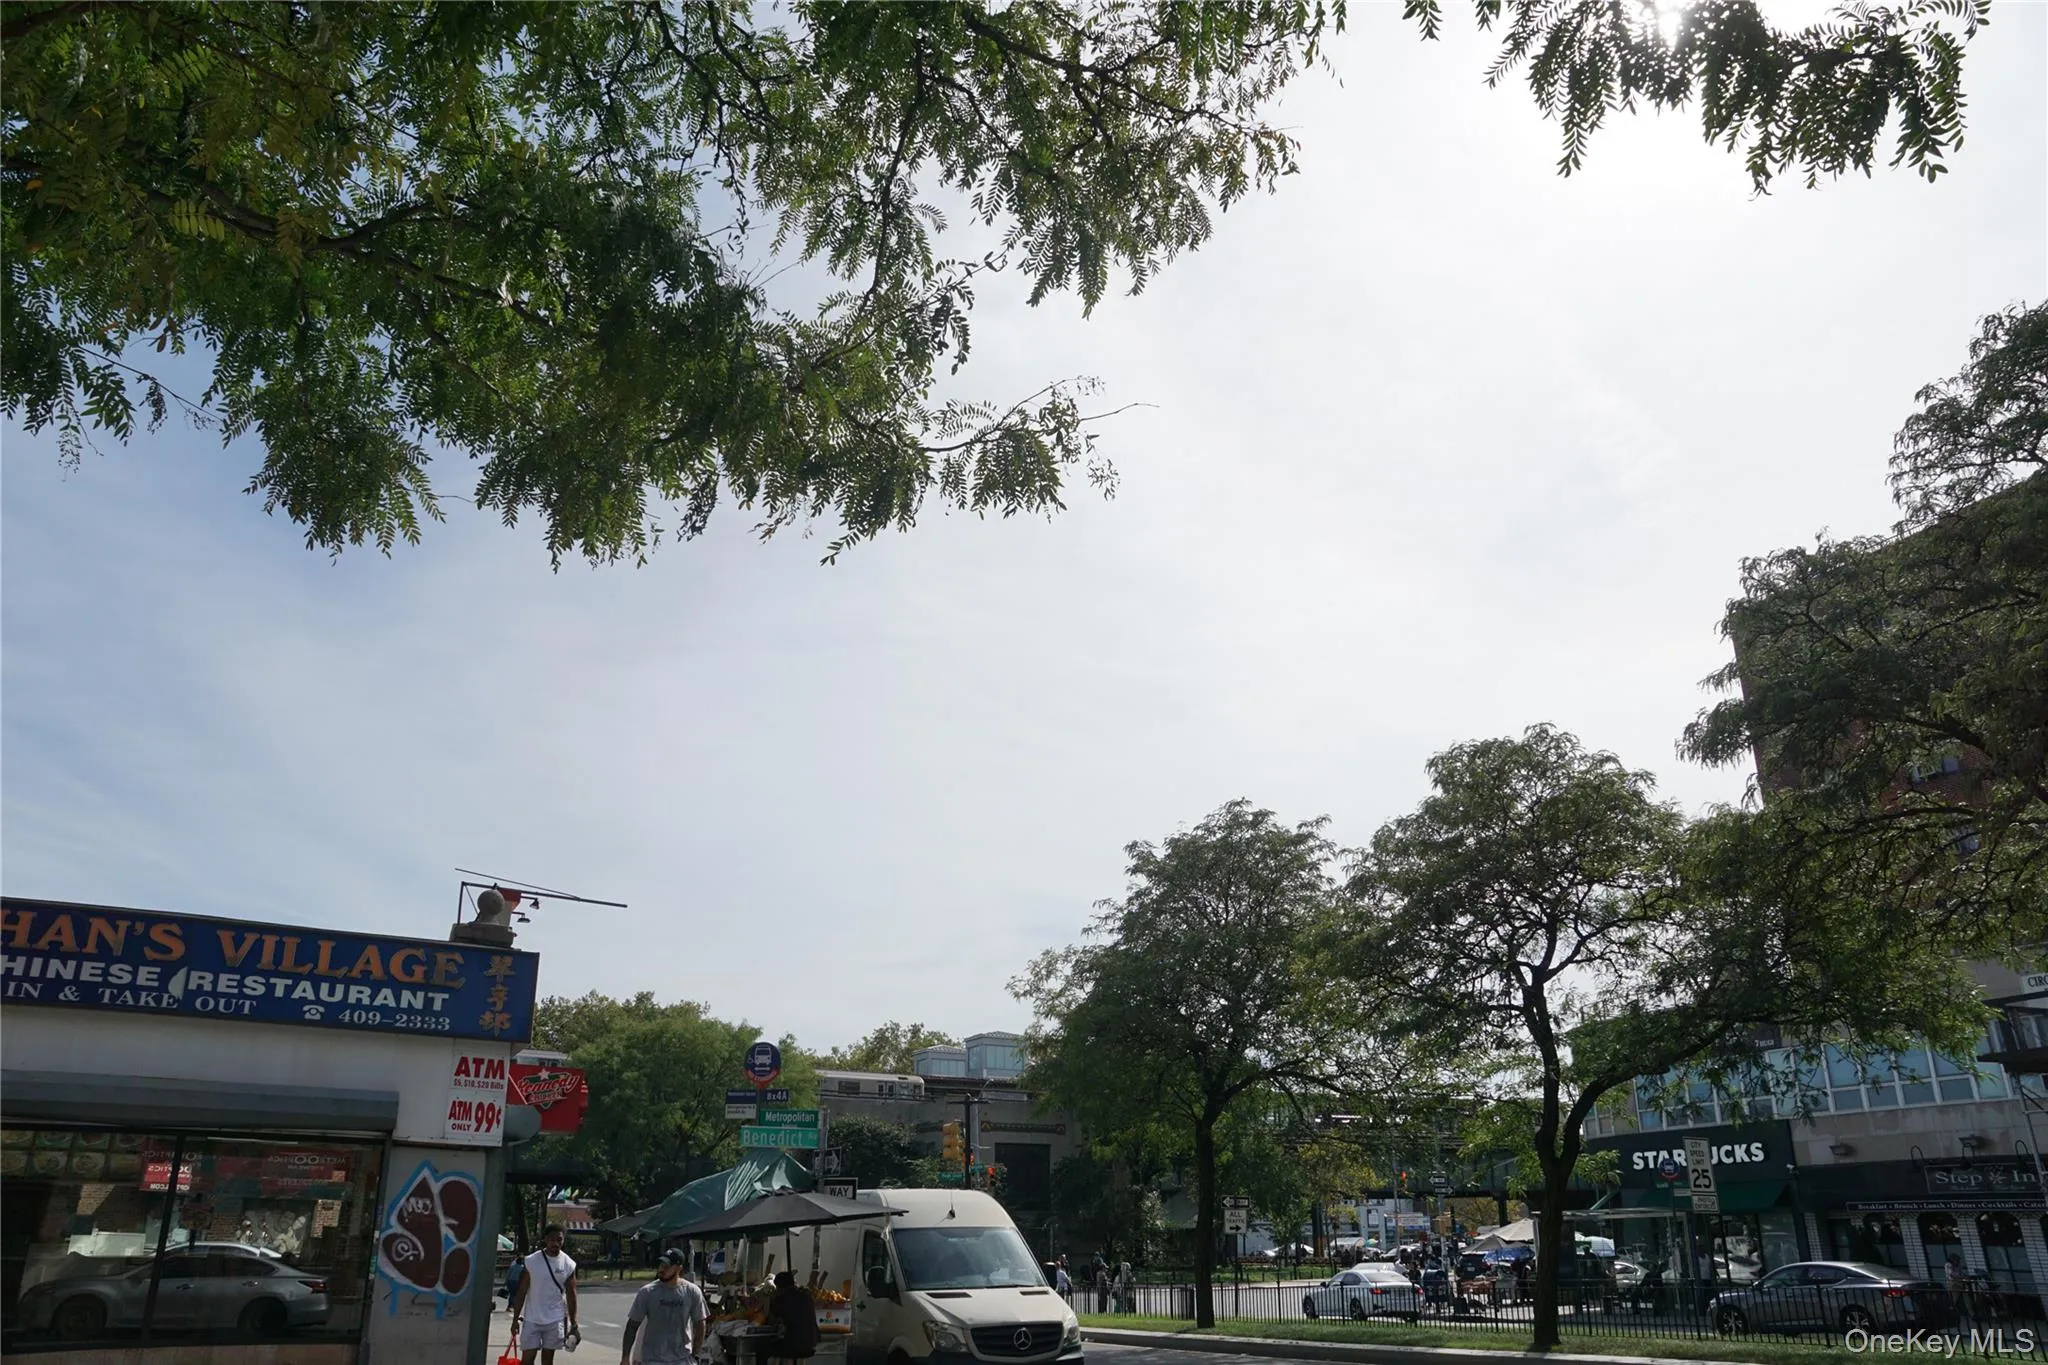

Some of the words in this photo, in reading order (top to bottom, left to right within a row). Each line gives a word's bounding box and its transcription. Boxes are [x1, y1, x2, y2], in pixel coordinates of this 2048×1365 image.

[0, 908, 186, 961] HAN'S
[217, 929, 466, 989] VILLAGE
[0, 954, 161, 987] HINESE
[187, 970, 450, 1011] RESTAURANT
[6, 980, 43, 999] IN
[58, 984, 81, 1002] &
[98, 987, 178, 1009] TAKE
[195, 996, 257, 1015] OUT
[338, 1009, 450, 1031] 409-2333
[454, 1056, 505, 1080] ATM
[448, 1100, 472, 1121] ATM
[474, 1101, 502, 1133] 99¢
[451, 1123, 472, 1131] ONLY
[765, 1111, 815, 1123] Metropolitan
[743, 1129, 803, 1146] Benedict
[1691, 1168, 1711, 1188] 25
[1935, 1171, 1983, 1186] Step
